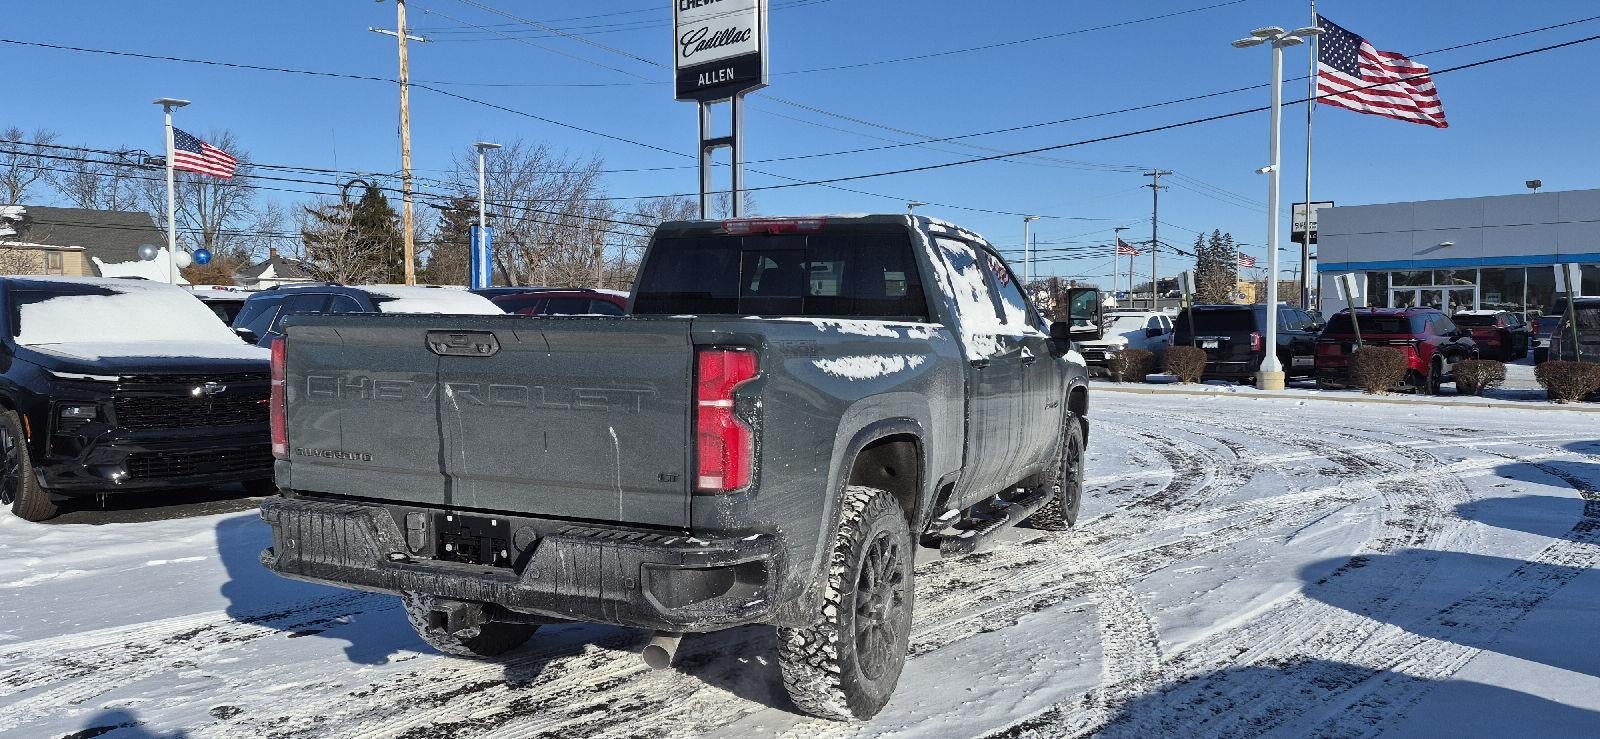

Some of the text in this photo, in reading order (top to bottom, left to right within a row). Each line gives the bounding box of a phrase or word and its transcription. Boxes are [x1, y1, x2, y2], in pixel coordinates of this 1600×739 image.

[680, 27, 751, 57] Cadillac
[698, 67, 734, 86] ALLEN
[307, 375, 657, 413] CHEVROLET
[295, 447, 372, 461] SILVERADO
